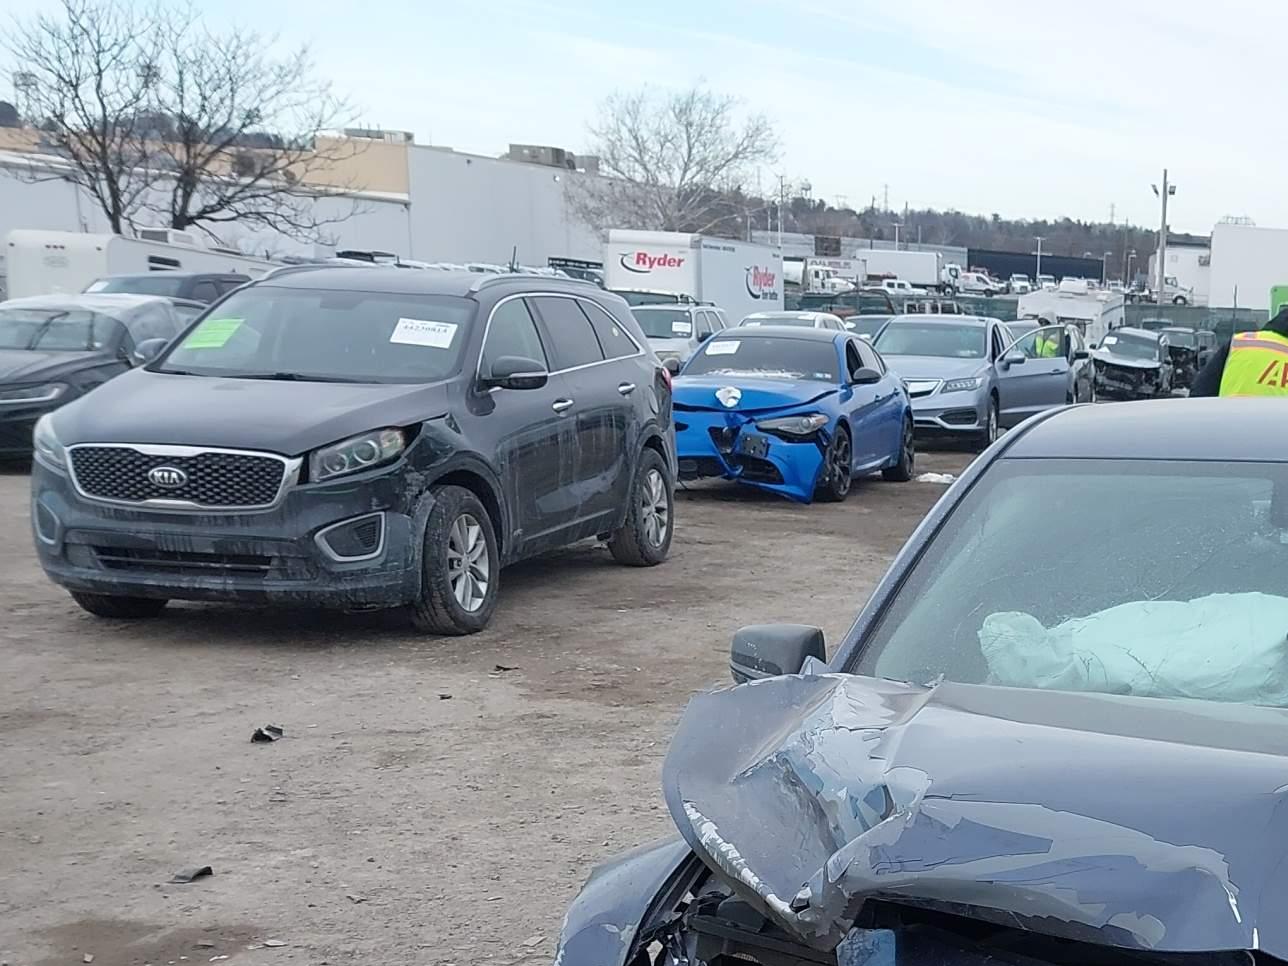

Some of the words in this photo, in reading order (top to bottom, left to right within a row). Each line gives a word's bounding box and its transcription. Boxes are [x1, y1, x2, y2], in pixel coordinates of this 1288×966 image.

[635, 252, 684, 269] Ryder
[752, 266, 775, 291] Ryder
[154, 471, 180, 484] KIA
